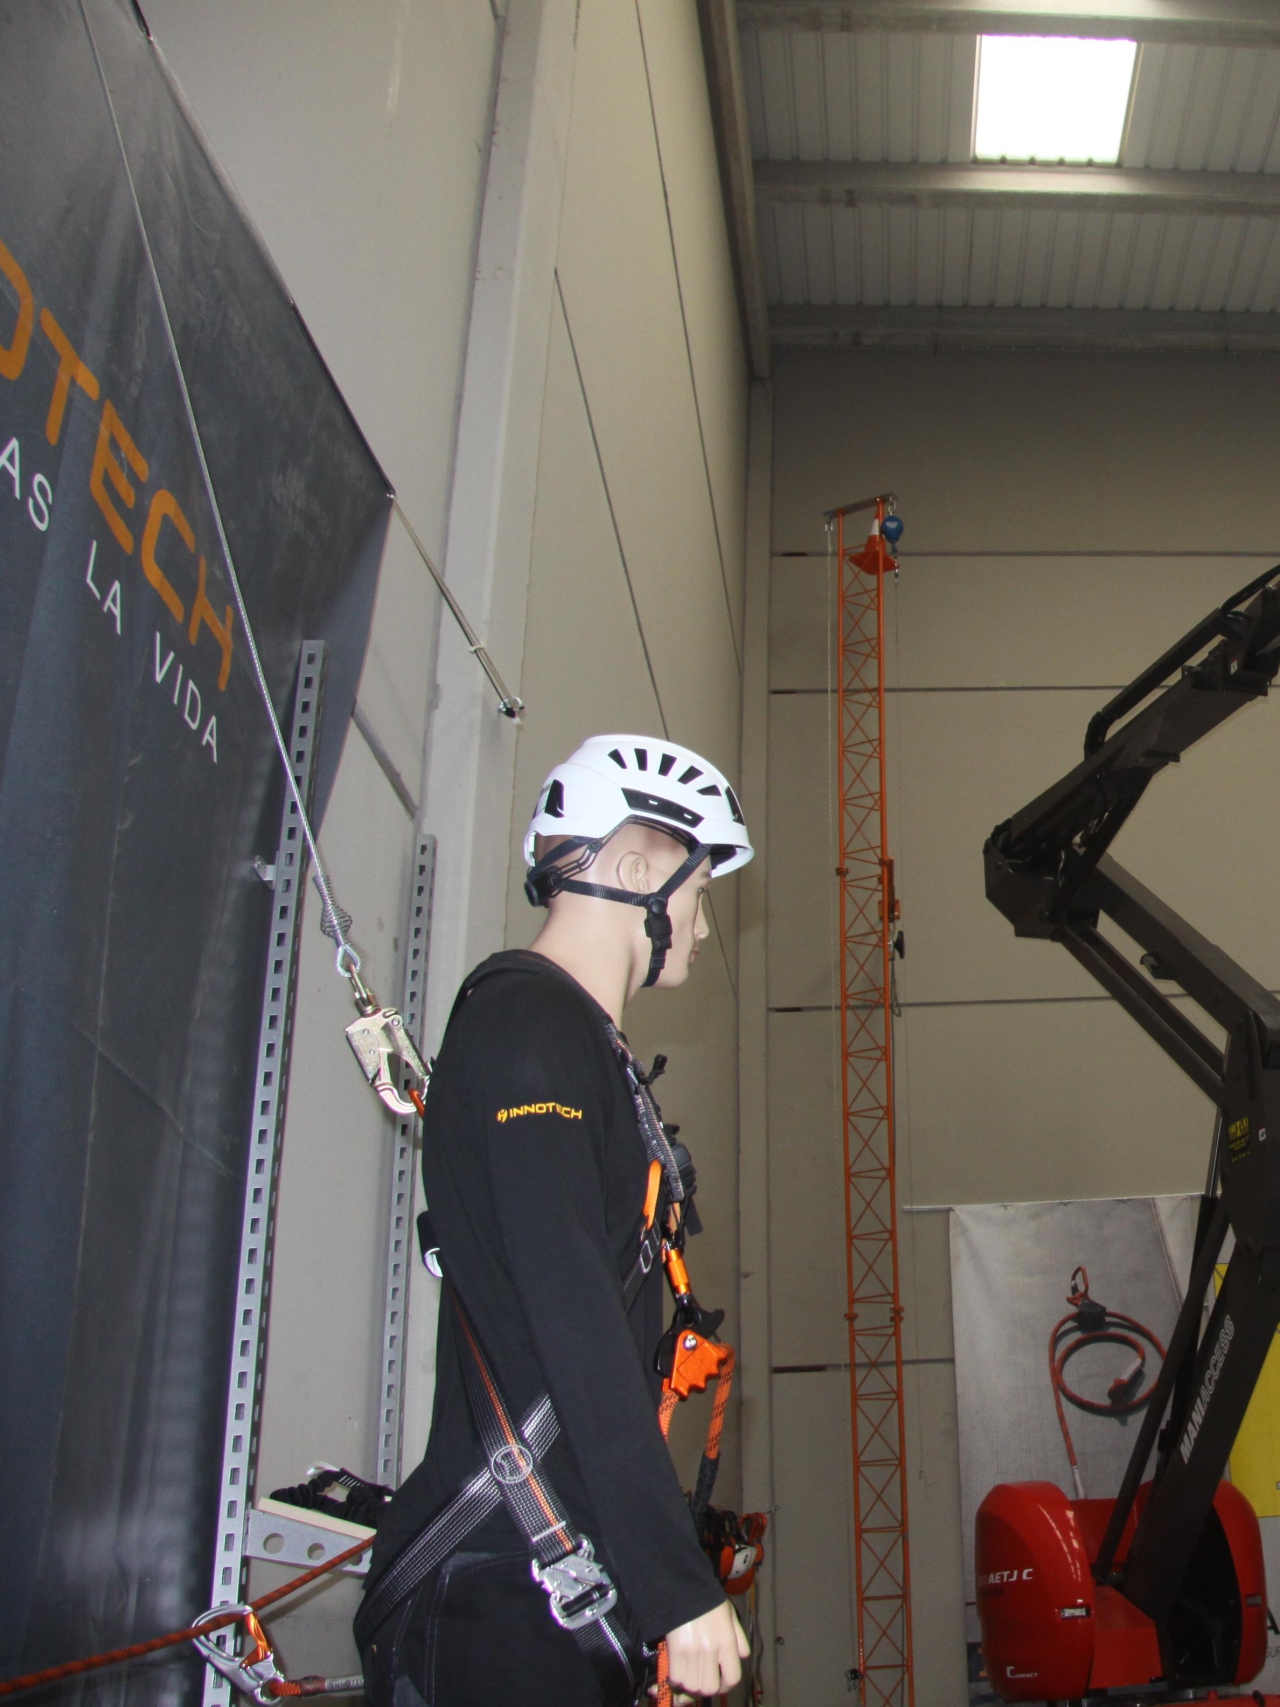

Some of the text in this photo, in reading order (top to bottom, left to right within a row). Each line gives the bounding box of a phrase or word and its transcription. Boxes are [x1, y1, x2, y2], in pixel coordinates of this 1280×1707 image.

[86, 540, 121, 636] LA
[154, 631, 218, 765] VIDA
[508, 1102, 583, 1120] INNOTECH
[1022, 1567, 1034, 1580] C
